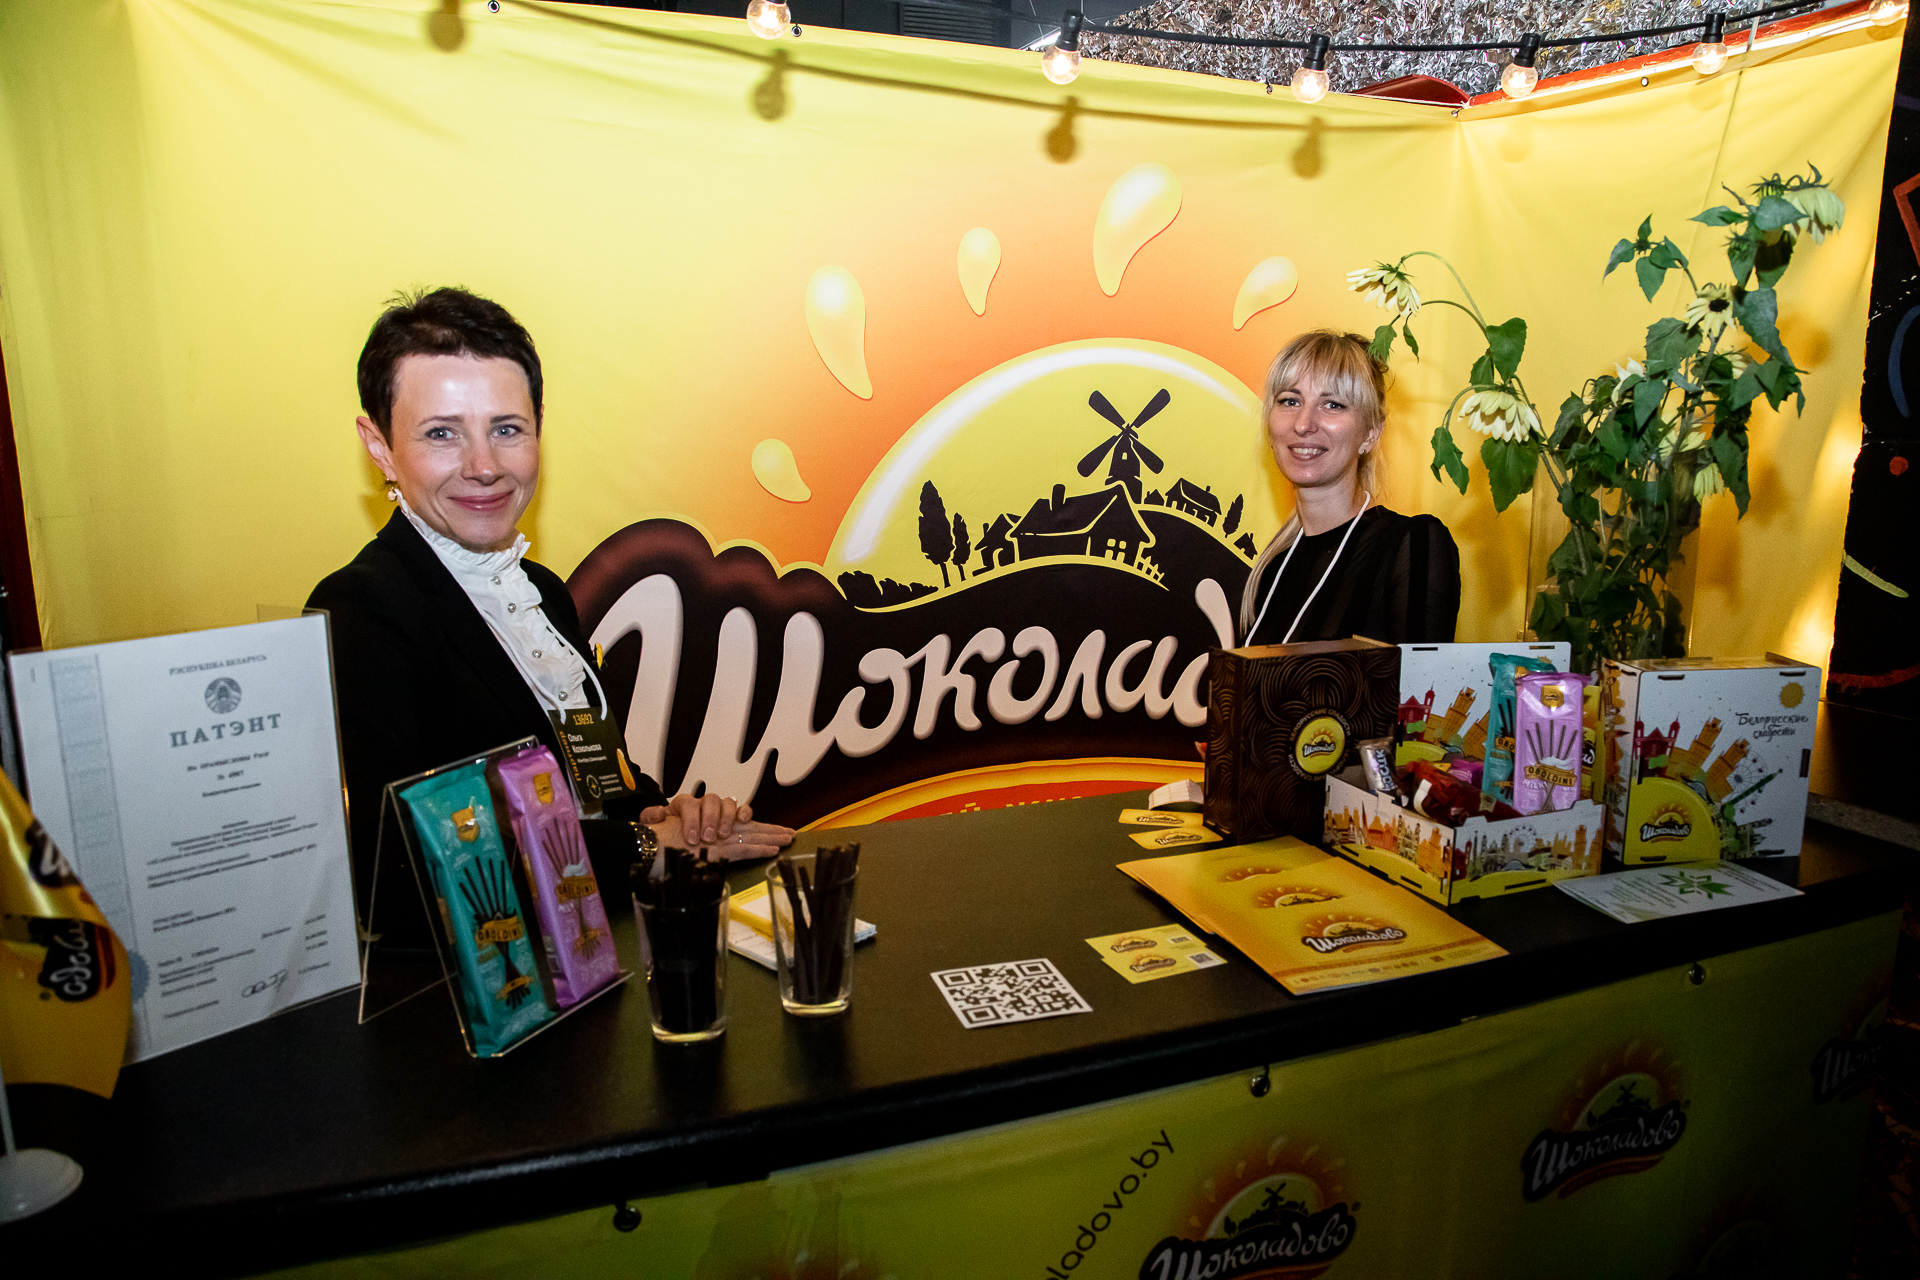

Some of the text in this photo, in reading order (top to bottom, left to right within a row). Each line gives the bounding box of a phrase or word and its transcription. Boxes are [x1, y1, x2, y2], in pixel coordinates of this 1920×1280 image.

[169, 713, 281, 747] ПАТЭНТ
[1735, 712, 1808, 729] Белорусские
[1753, 724, 1795, 742] сладости
[1527, 766, 1573, 785] OBOLDINI
[1305, 928, 1404, 952] Шоколадово
[1529, 1108, 1681, 1192] Шоколадово
[1046, 1130, 1174, 1280] ladovo.by
